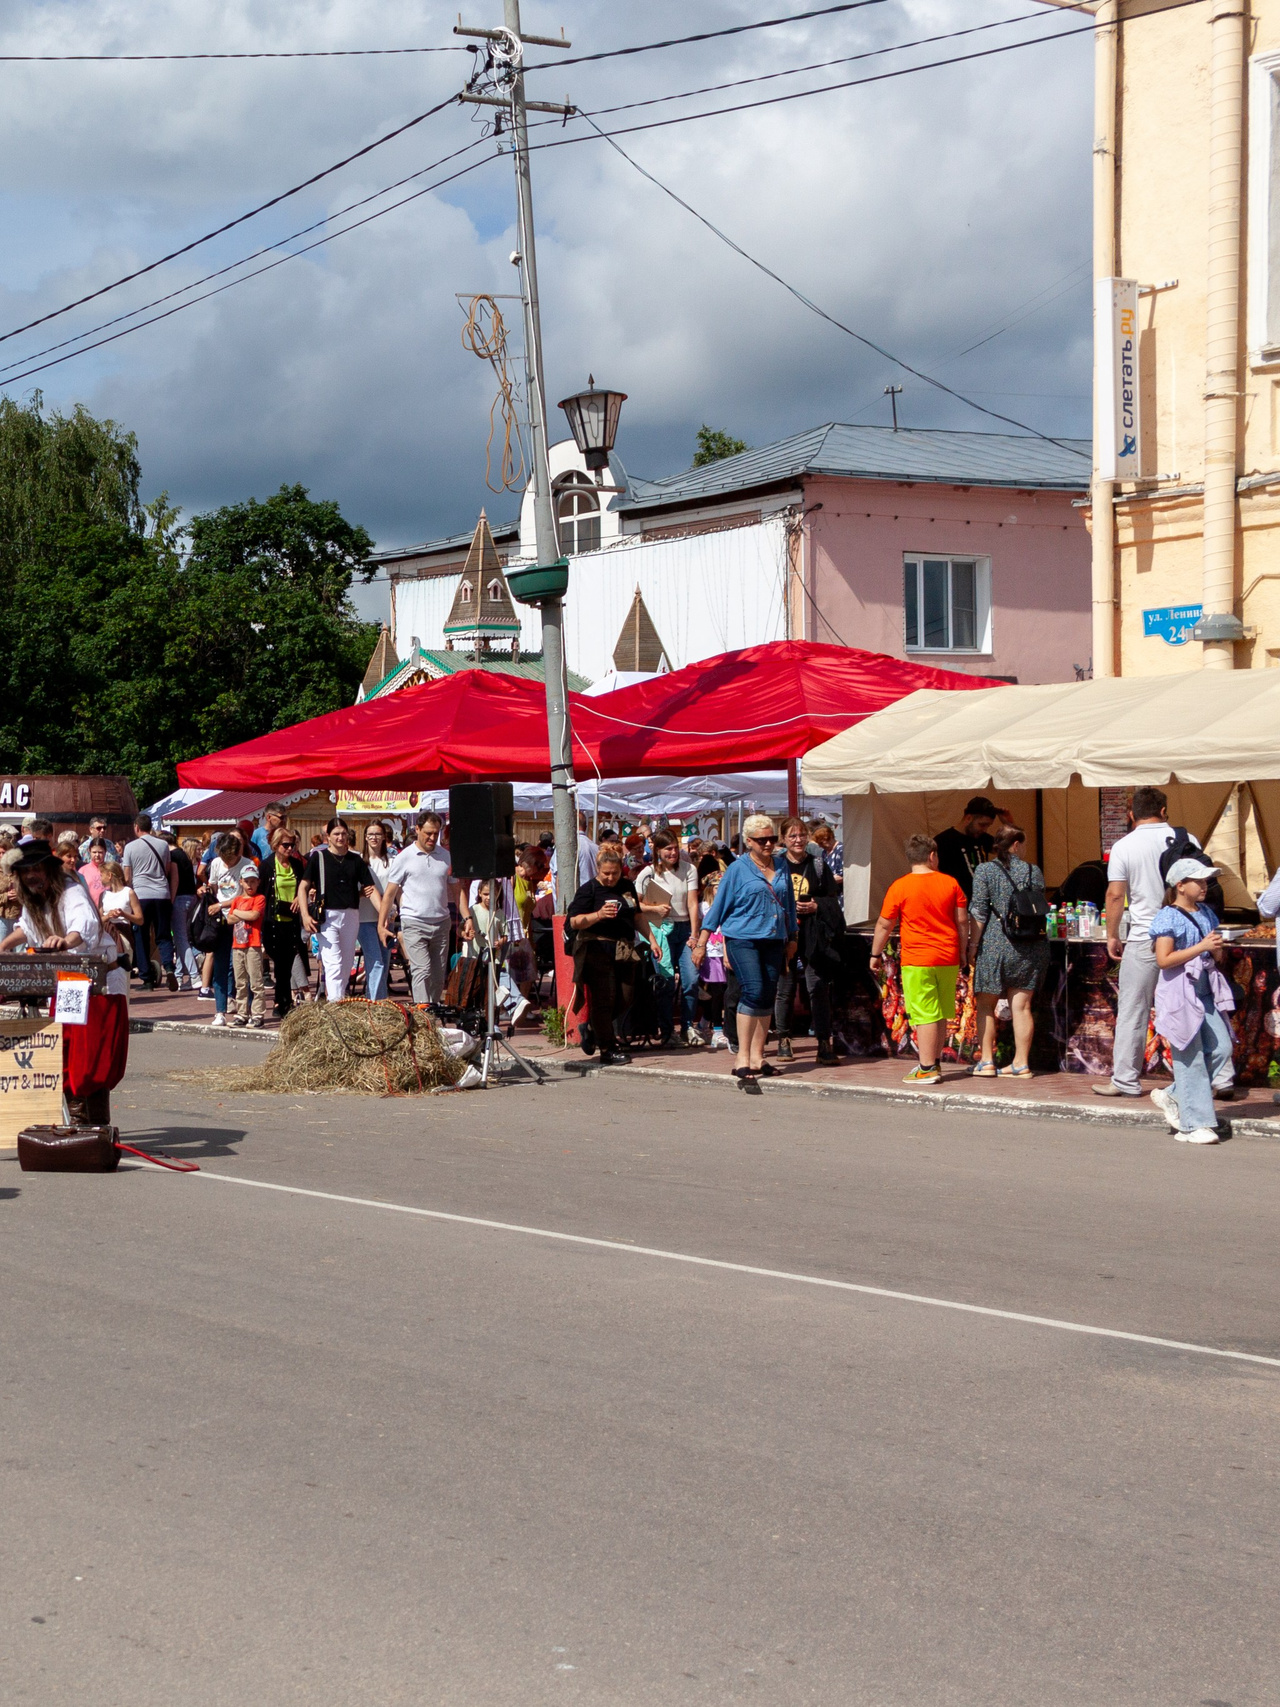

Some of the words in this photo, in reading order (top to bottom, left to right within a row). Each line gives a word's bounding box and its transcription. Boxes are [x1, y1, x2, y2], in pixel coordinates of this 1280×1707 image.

[1120, 309, 1135, 429] слетать.ру
[1148, 613, 1163, 625] ул.
[33, 1073, 60, 1091] Шоу
